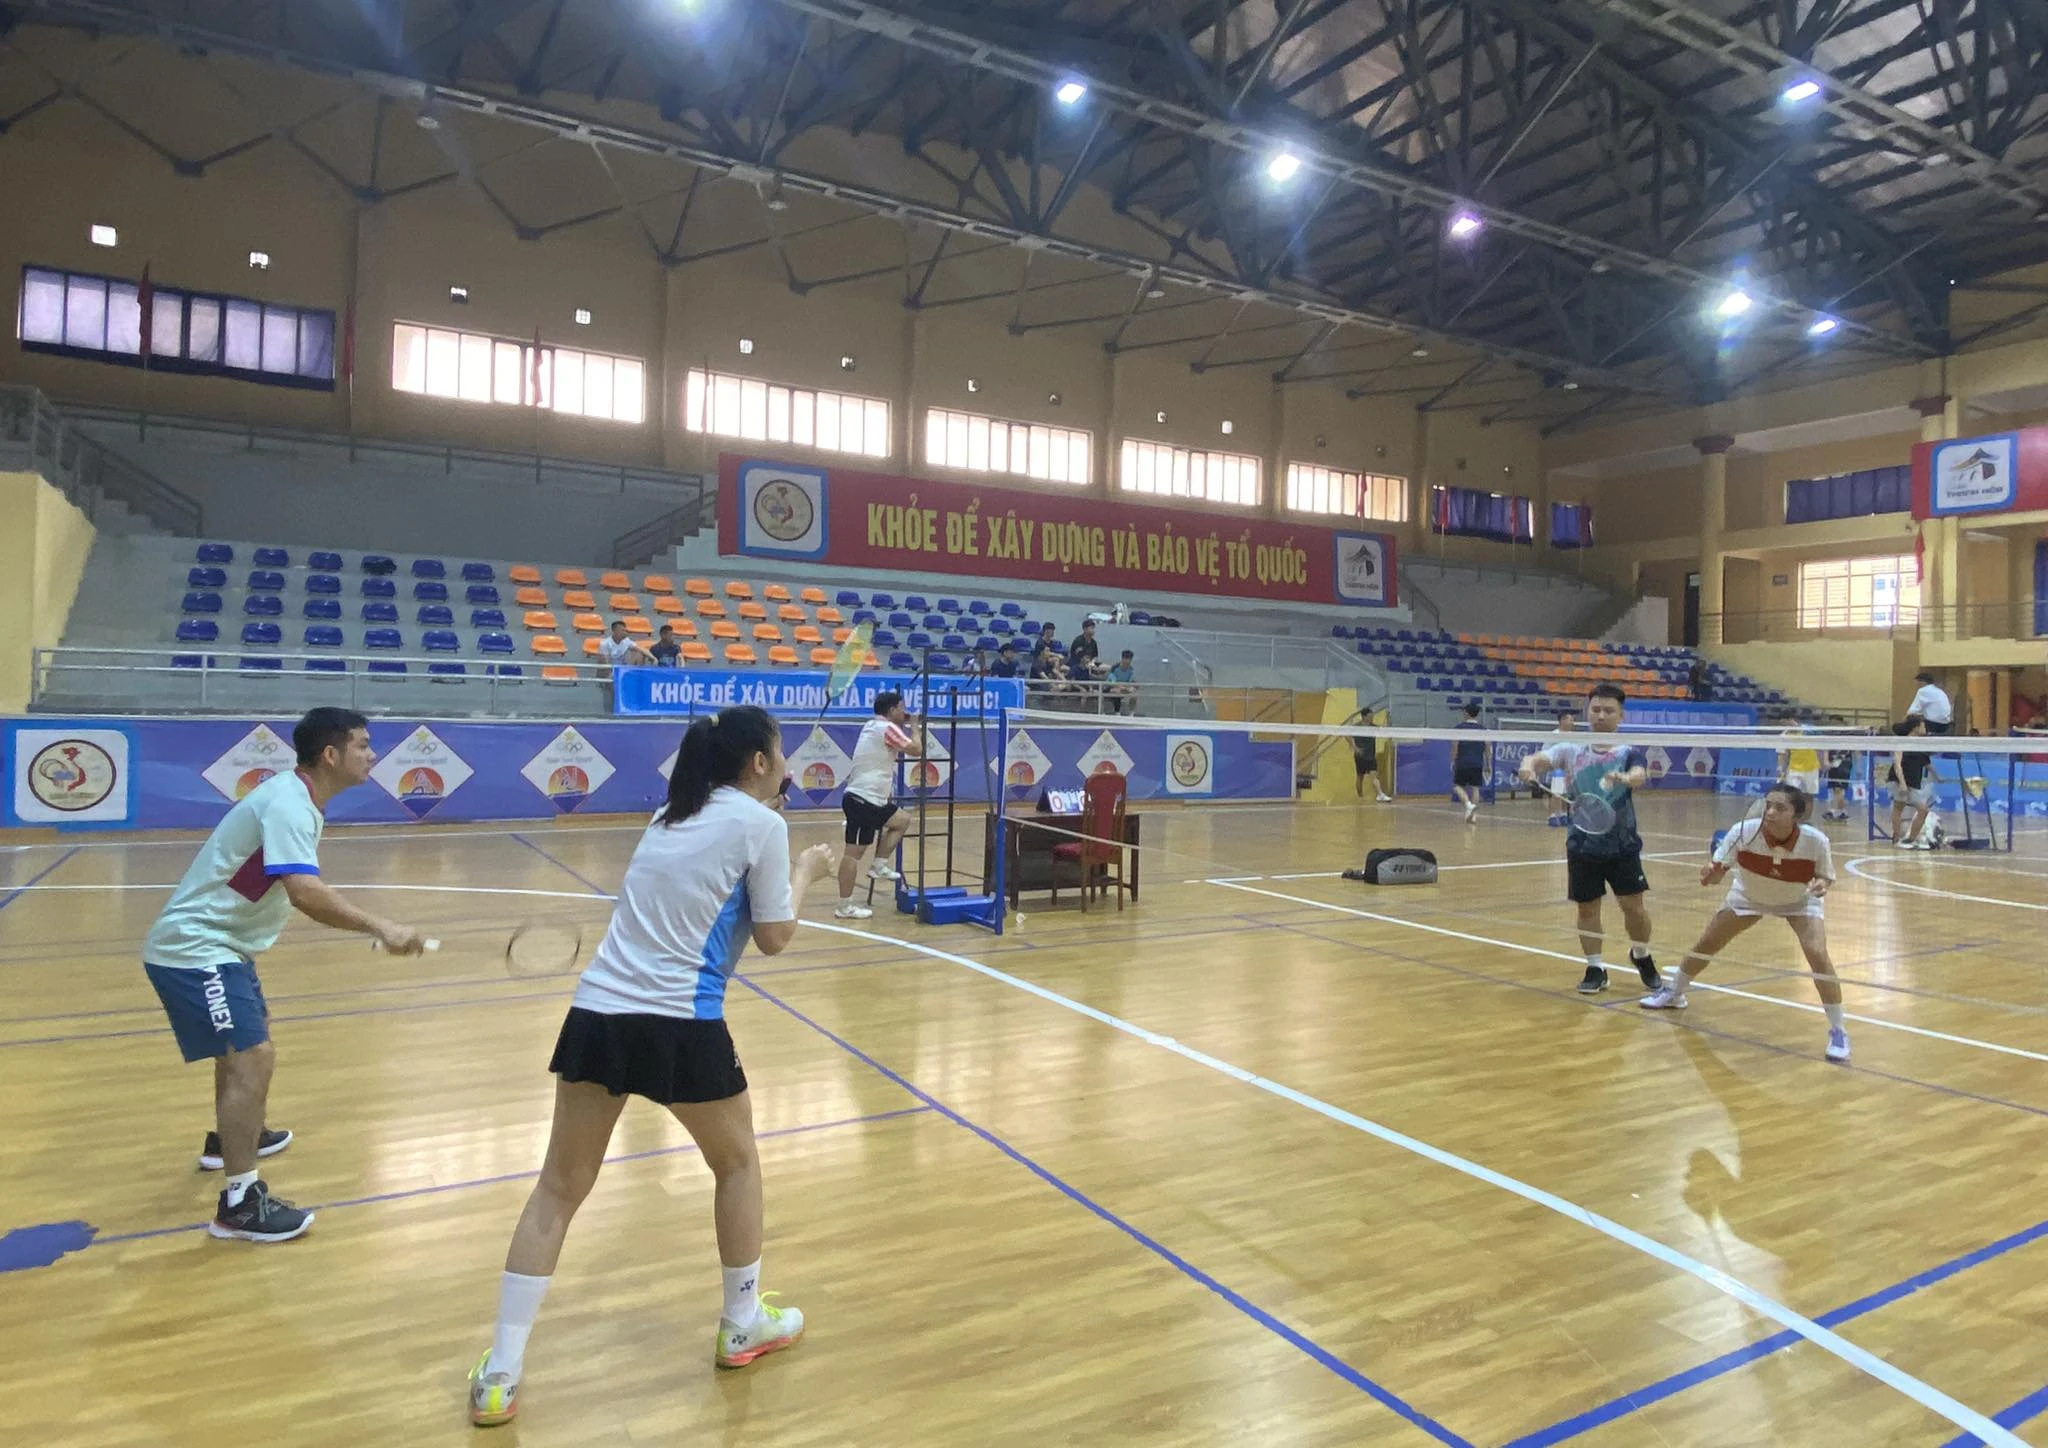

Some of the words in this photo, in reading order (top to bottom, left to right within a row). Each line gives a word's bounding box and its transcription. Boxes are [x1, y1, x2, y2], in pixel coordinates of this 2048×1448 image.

[868, 493, 937, 551] KHỎE
[946, 497, 978, 555] ĐỂ
[987, 509, 1033, 559] XÂY
[1042, 521, 1105, 572] DỰNG
[1112, 523, 1140, 569] VÀ
[1147, 521, 1189, 574] BẢO
[1196, 531, 1220, 585] VỆ
[1226, 528, 1250, 579] TỔ
[1256, 536, 1307, 585] QUỐC
[651, 675, 704, 704] KHỎE
[741, 681, 778, 706] XÂY
[203, 973, 234, 1033] YONEX
